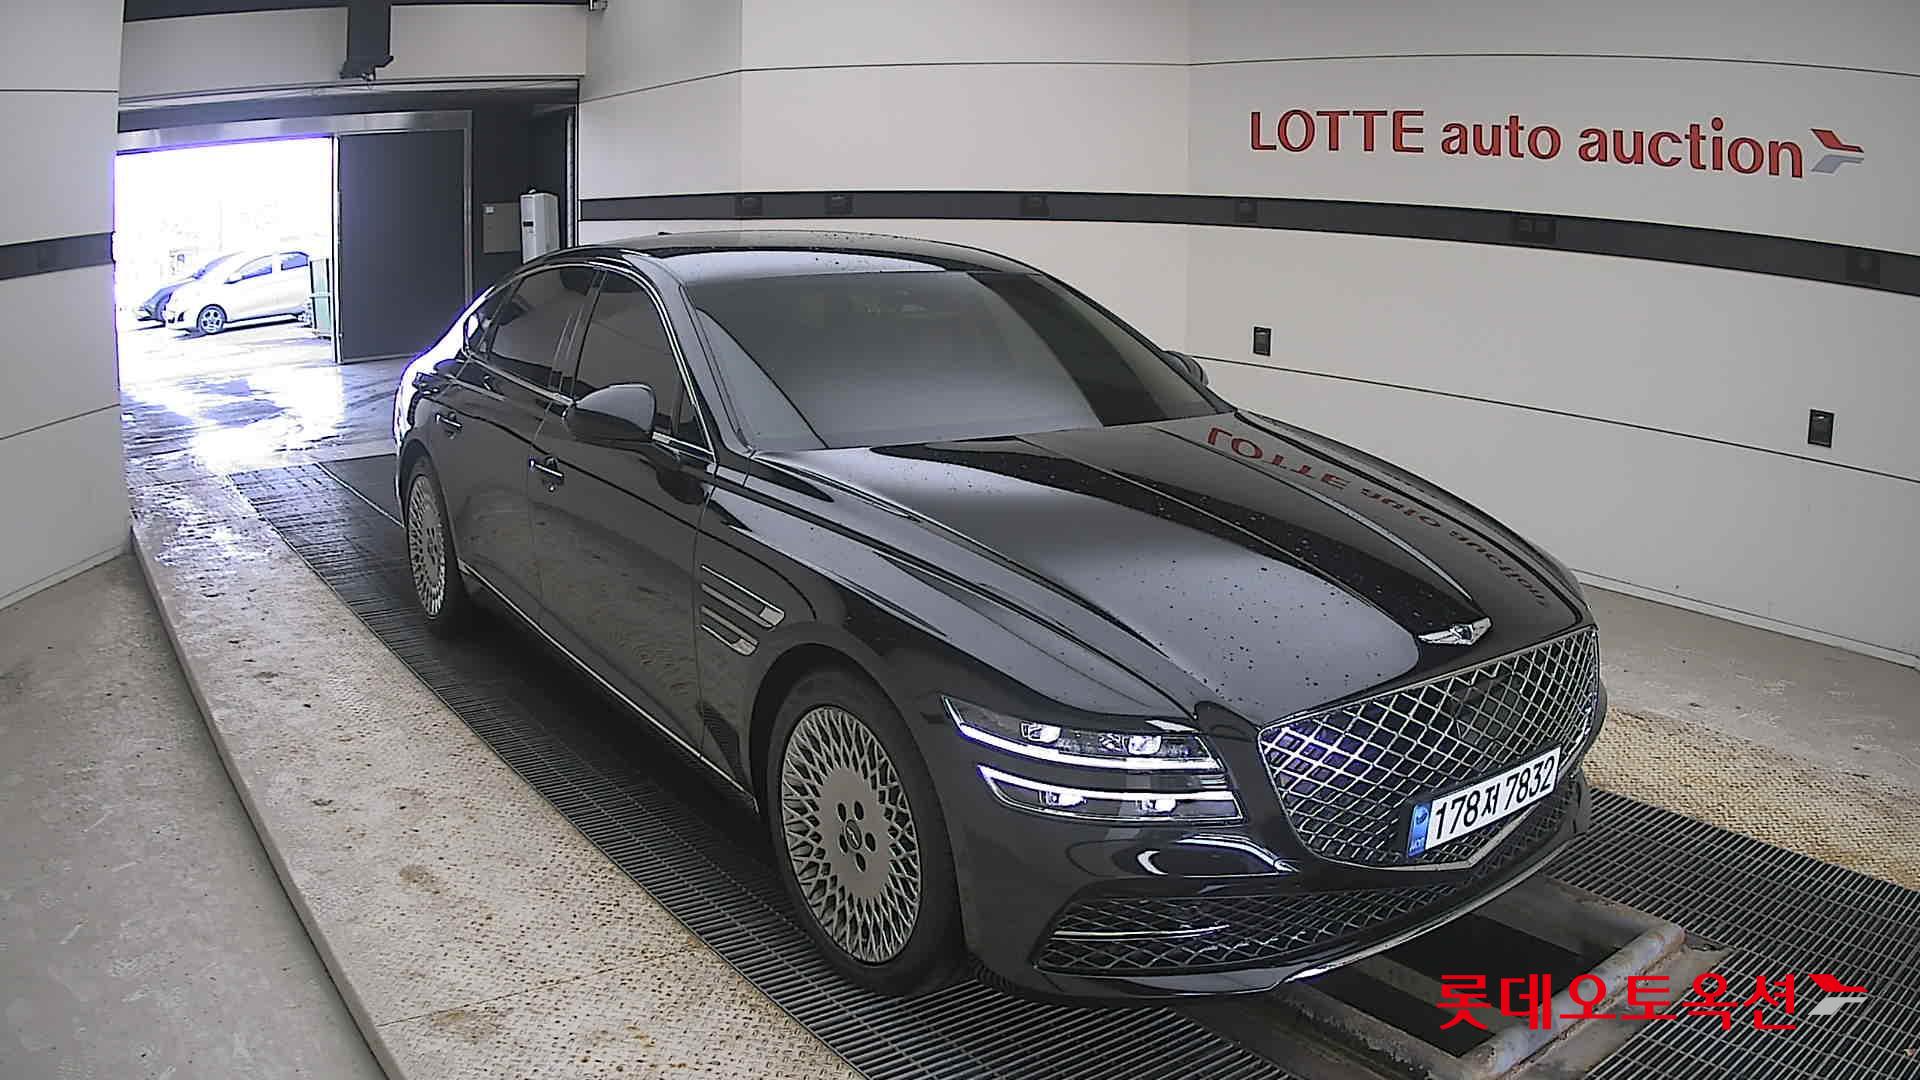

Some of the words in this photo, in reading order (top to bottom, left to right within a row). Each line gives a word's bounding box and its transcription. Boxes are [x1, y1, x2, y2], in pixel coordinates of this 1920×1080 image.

[1250, 110, 1424, 153] LOTTE
[1441, 115, 1561, 160] auto
[1578, 117, 1803, 179] auction
[1435, 783, 1500, 840] 178저
[1504, 755, 1555, 811] 7832
